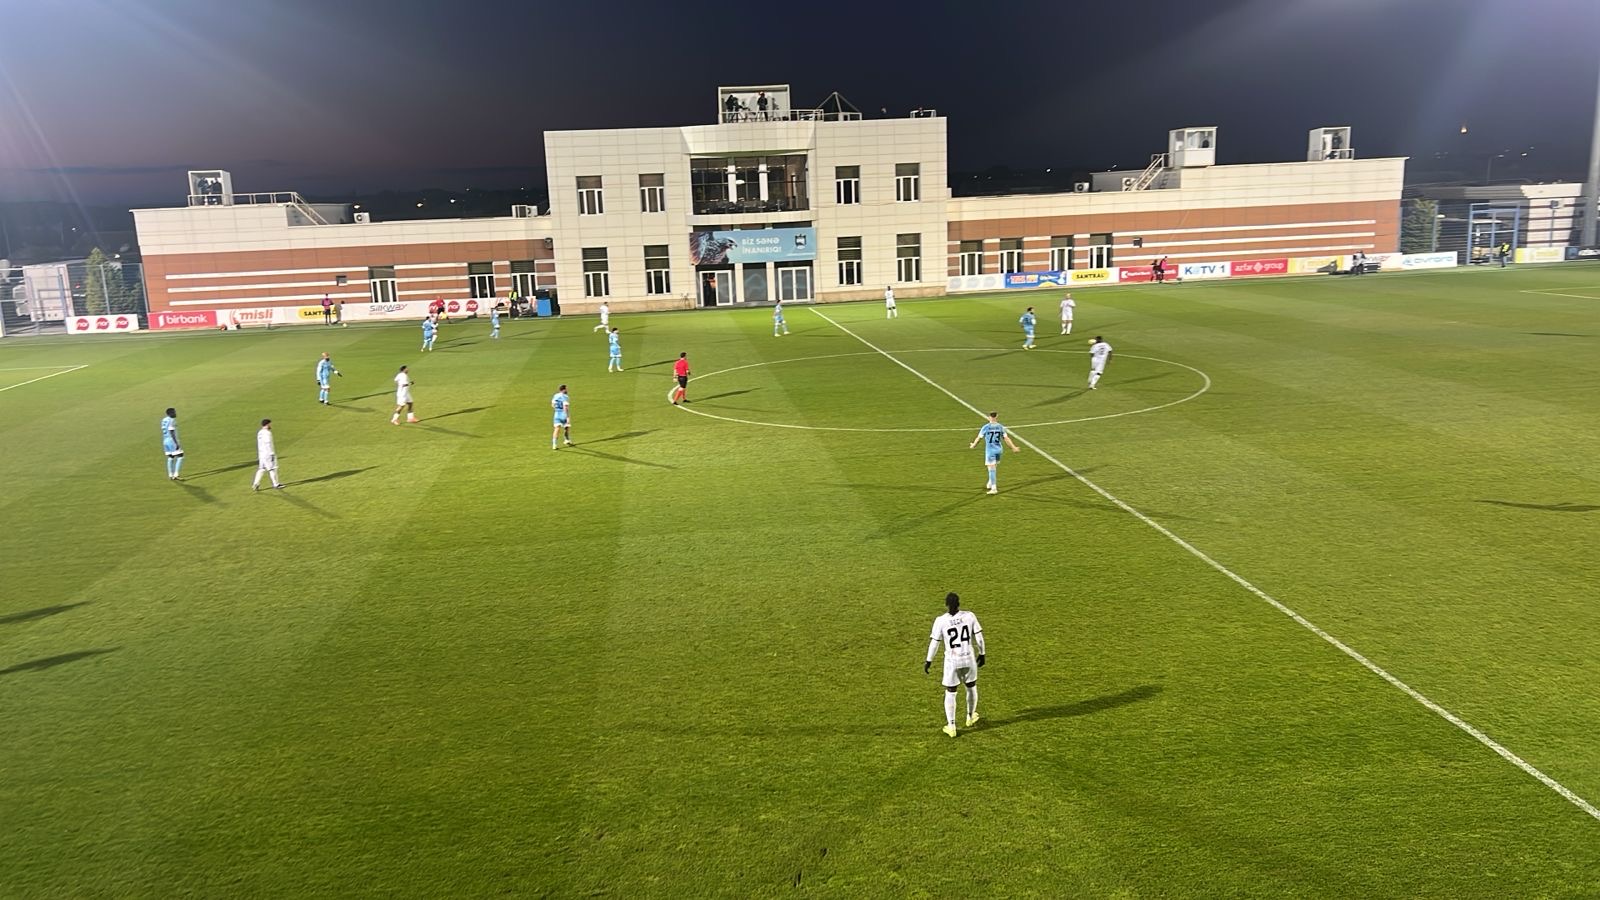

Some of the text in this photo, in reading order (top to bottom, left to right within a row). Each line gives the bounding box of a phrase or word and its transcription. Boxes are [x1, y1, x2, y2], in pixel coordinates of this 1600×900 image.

[1263, 262, 1285, 271] group
[166, 315, 208, 325] birbank
[239, 309, 273, 320] misli
[988, 431, 1001, 444] 73
[947, 625, 970, 649] 24
